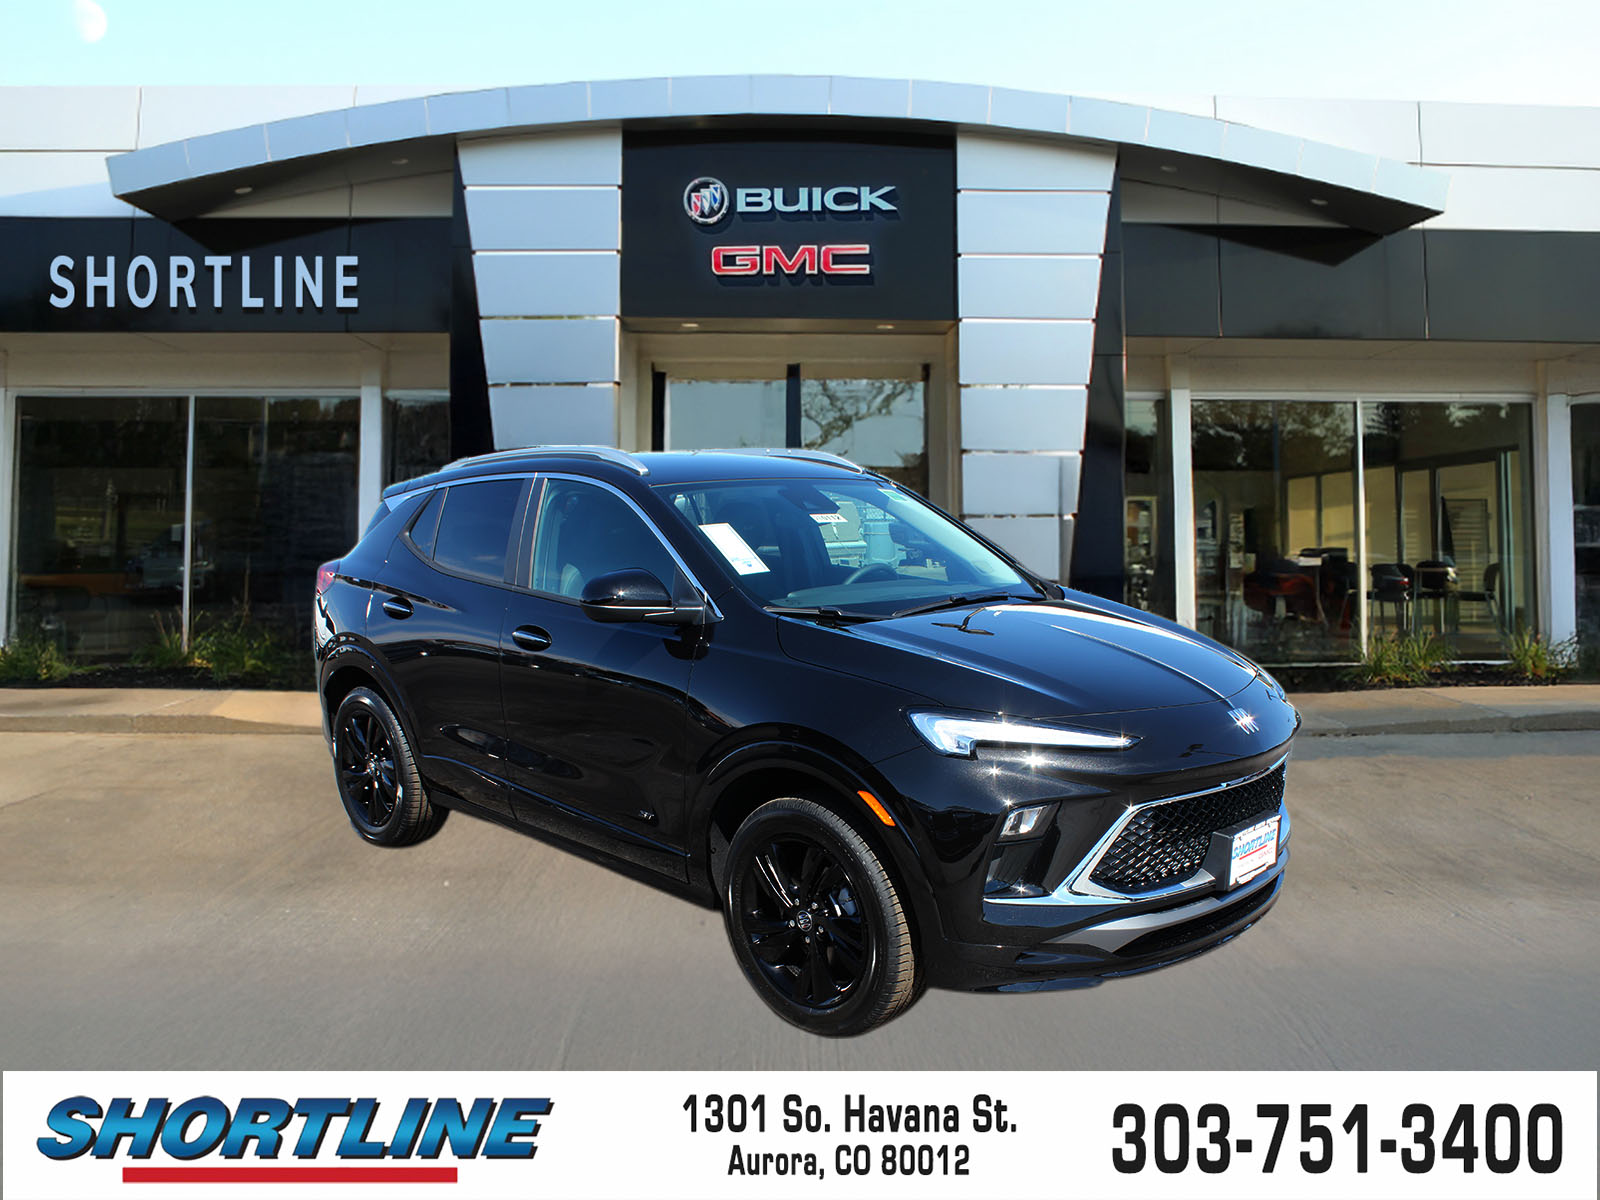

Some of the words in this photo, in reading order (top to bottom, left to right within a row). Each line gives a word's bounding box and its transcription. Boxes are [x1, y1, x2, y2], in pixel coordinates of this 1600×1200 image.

[736, 186, 898, 213] BUICK
[711, 244, 871, 275] GMC
[48, 254, 361, 309] SHORTLINE
[1231, 828, 1277, 860] SHORTLINE
